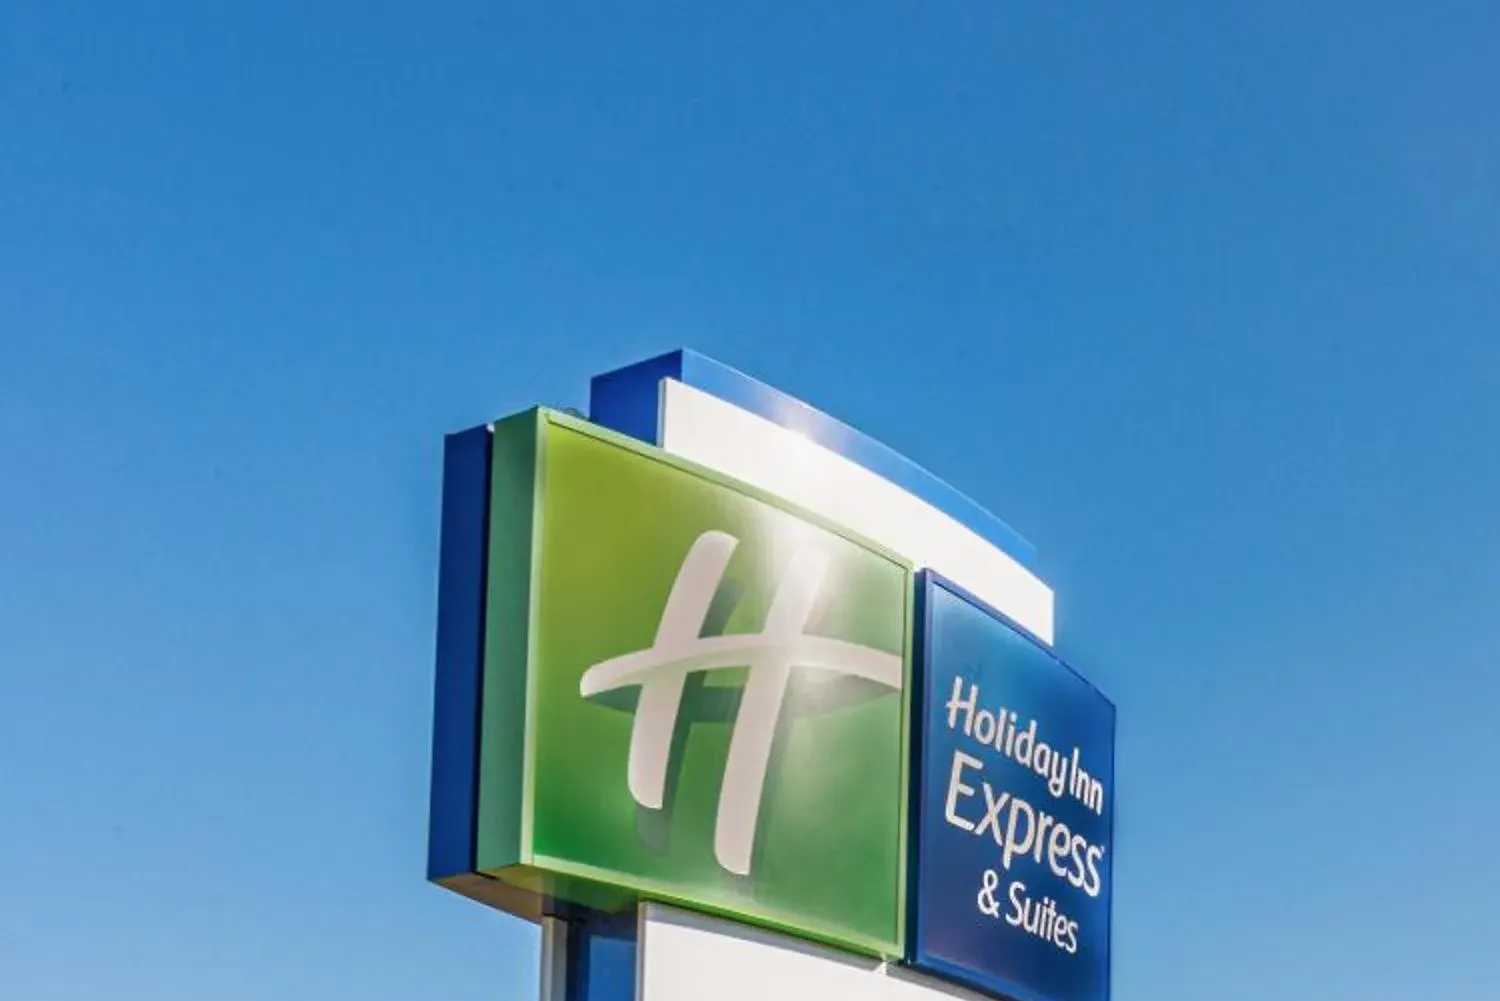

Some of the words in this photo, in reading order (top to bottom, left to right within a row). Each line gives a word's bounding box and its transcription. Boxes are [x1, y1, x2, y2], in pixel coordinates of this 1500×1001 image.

[578, 530, 903, 876] H
[946, 675, 1068, 798] Holiday
[1070, 747, 1104, 816] Inn
[945, 750, 1103, 897] Express
[977, 869, 999, 918] &
[1005, 881, 1078, 954] Suites
